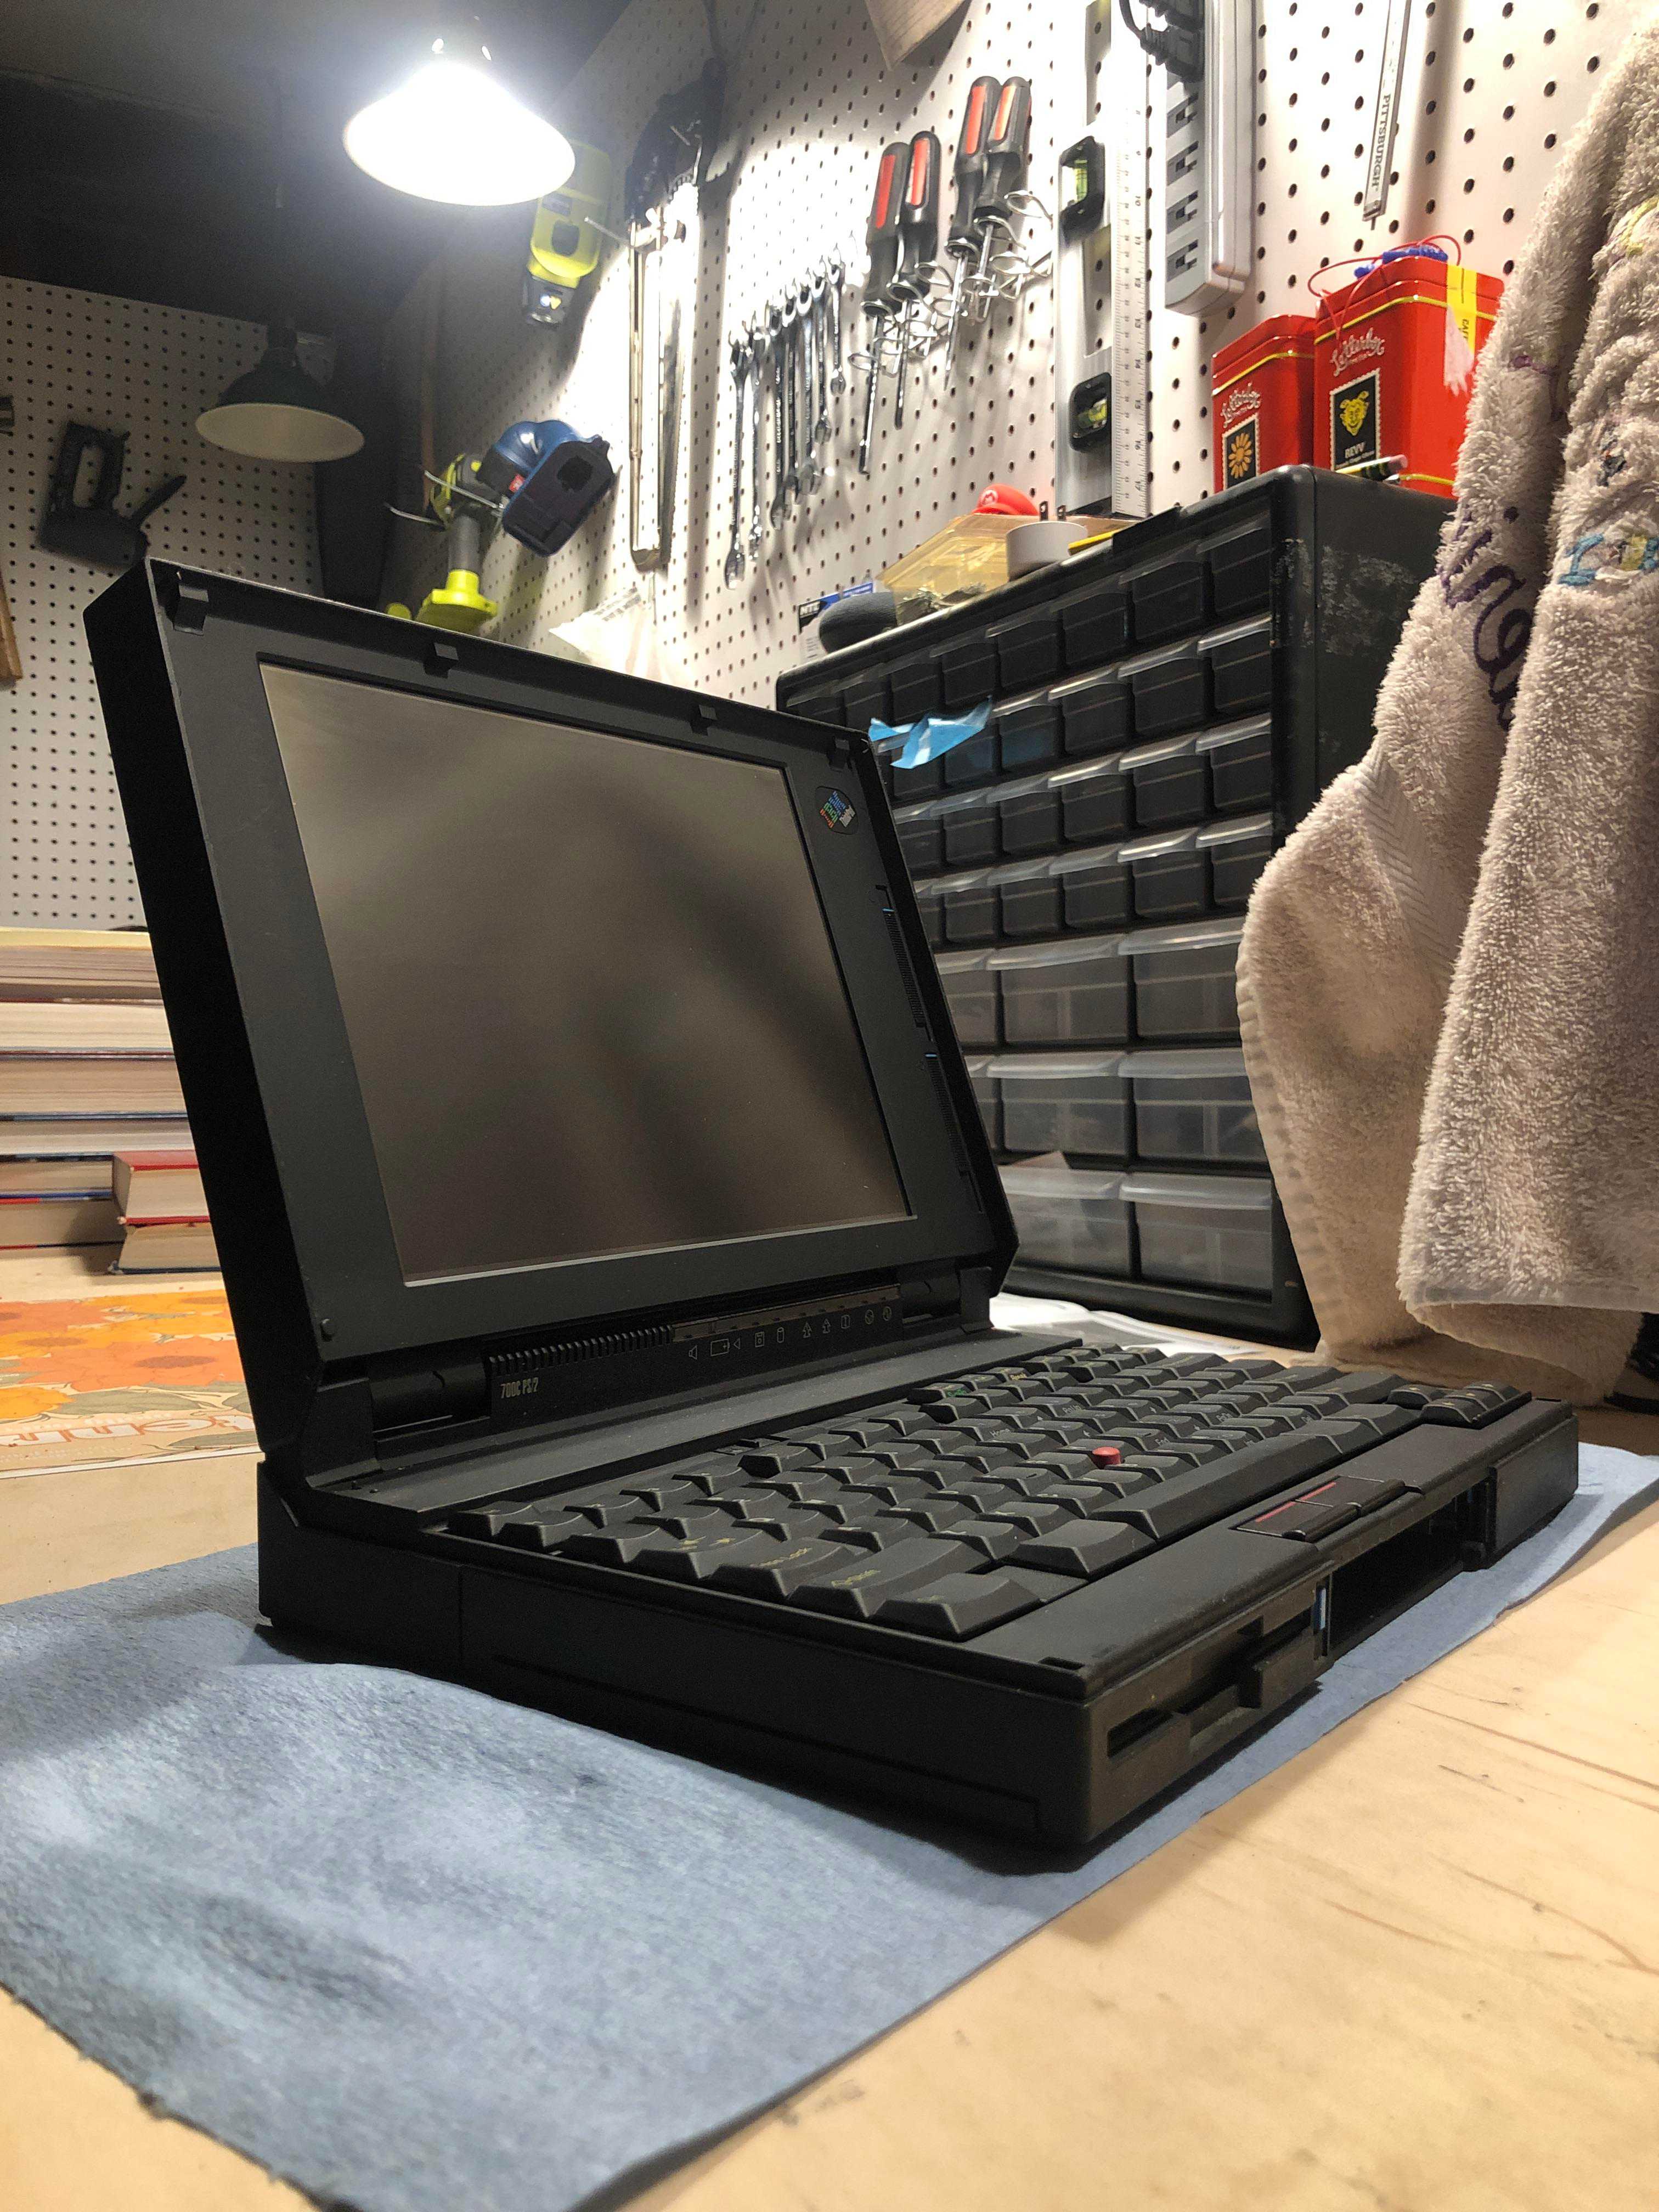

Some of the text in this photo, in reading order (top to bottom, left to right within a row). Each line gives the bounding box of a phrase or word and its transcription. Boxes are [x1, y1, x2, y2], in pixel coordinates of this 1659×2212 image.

[1372, 94, 1391, 187] PITTSBURGH
[1135, 278, 1141, 288] 12
[1135, 318, 1141, 329] 13
[1135, 359, 1141, 369] 14
[1135, 399, 1141, 410] 15
[1135, 440, 1141, 450] 16
[1135, 481, 1141, 491] 17
[820, 791, 846, 828] IBM
[500, 1380, 521, 1398] 700C
